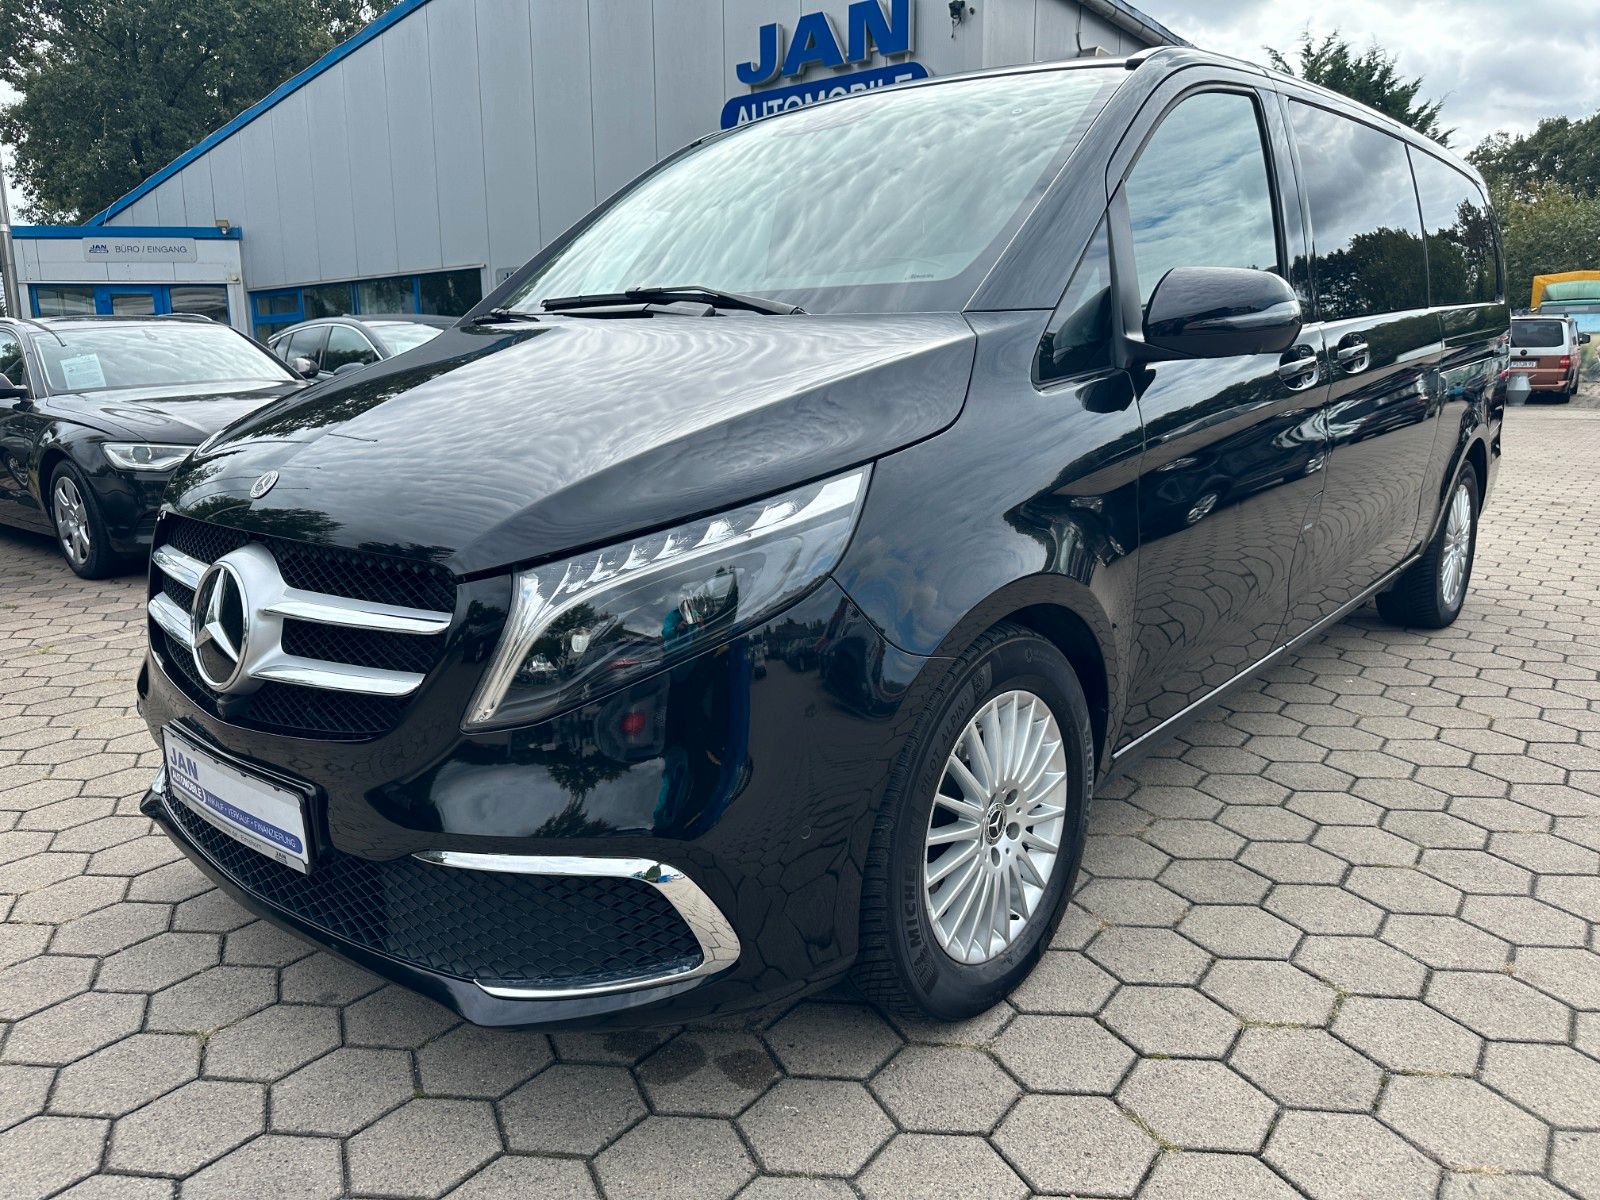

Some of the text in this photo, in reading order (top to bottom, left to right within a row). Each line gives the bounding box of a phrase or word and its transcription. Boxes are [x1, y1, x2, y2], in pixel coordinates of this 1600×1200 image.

[736, 0, 912, 85] JAN
[115, 244, 140, 254] BÜRO
[147, 245, 188, 254] EINGANG
[170, 747, 199, 781] JAN
